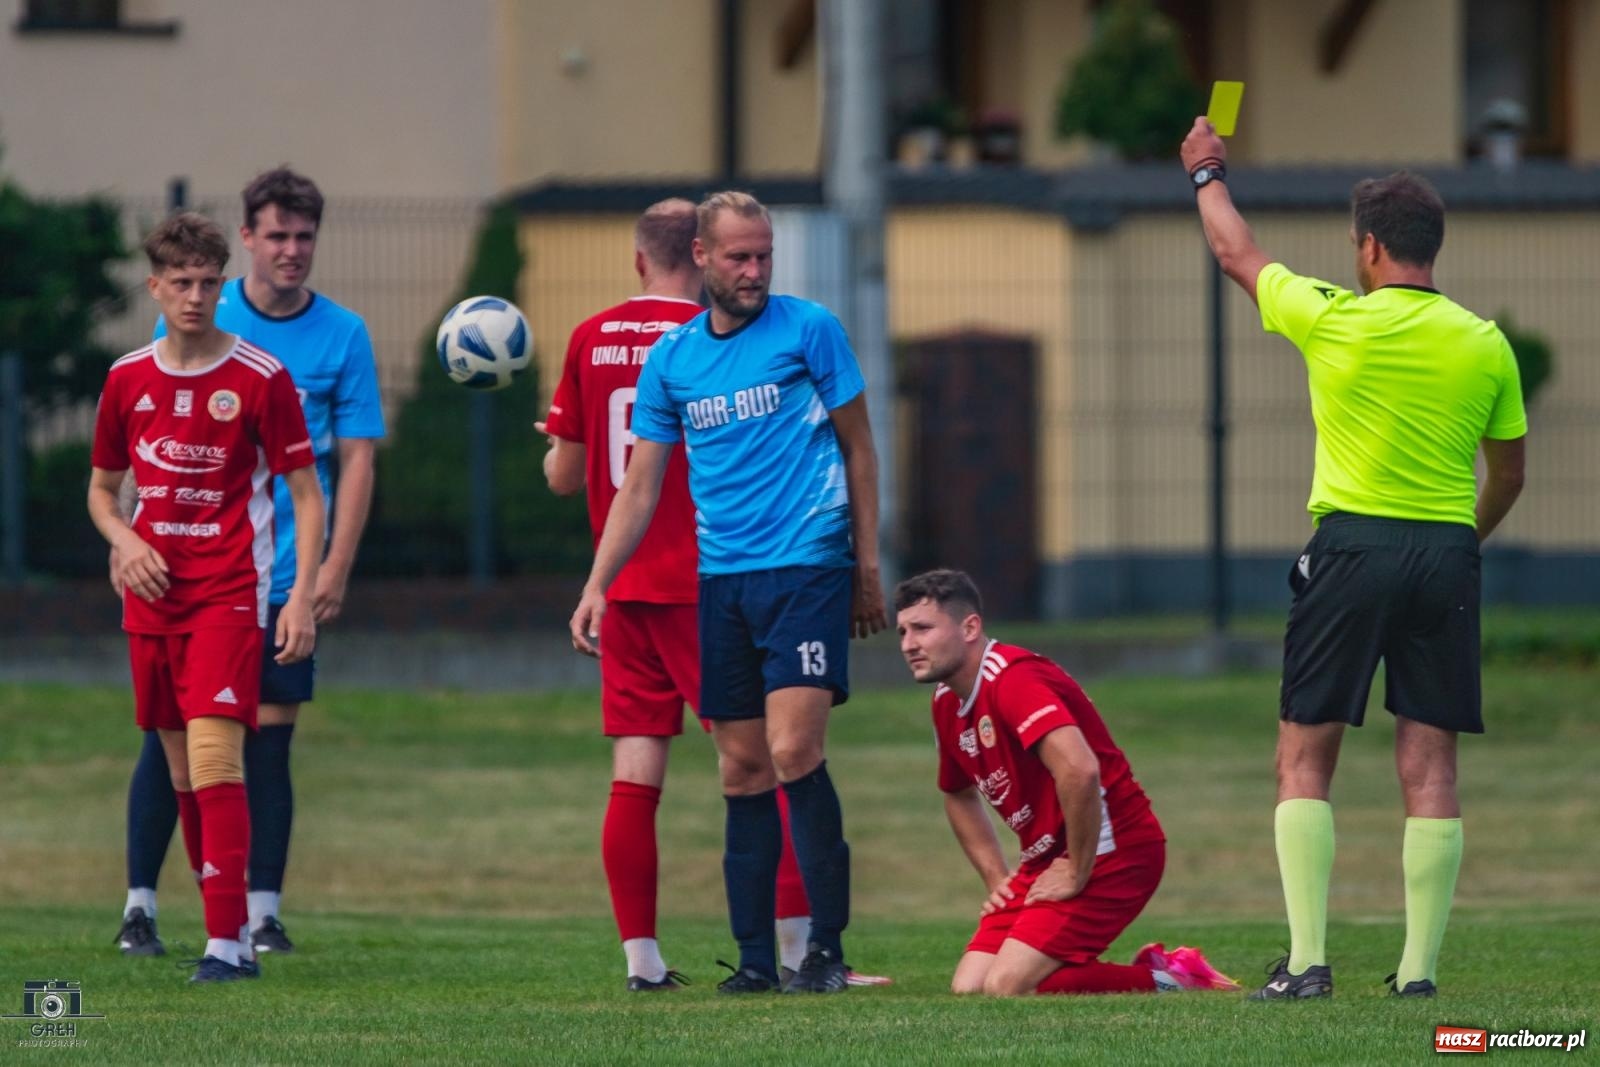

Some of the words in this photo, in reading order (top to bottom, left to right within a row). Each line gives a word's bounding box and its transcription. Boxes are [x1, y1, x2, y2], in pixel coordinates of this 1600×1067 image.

[591, 345, 629, 366] UNIA
[686, 383, 780, 431] DAR-BUD
[797, 641, 827, 676] 13
